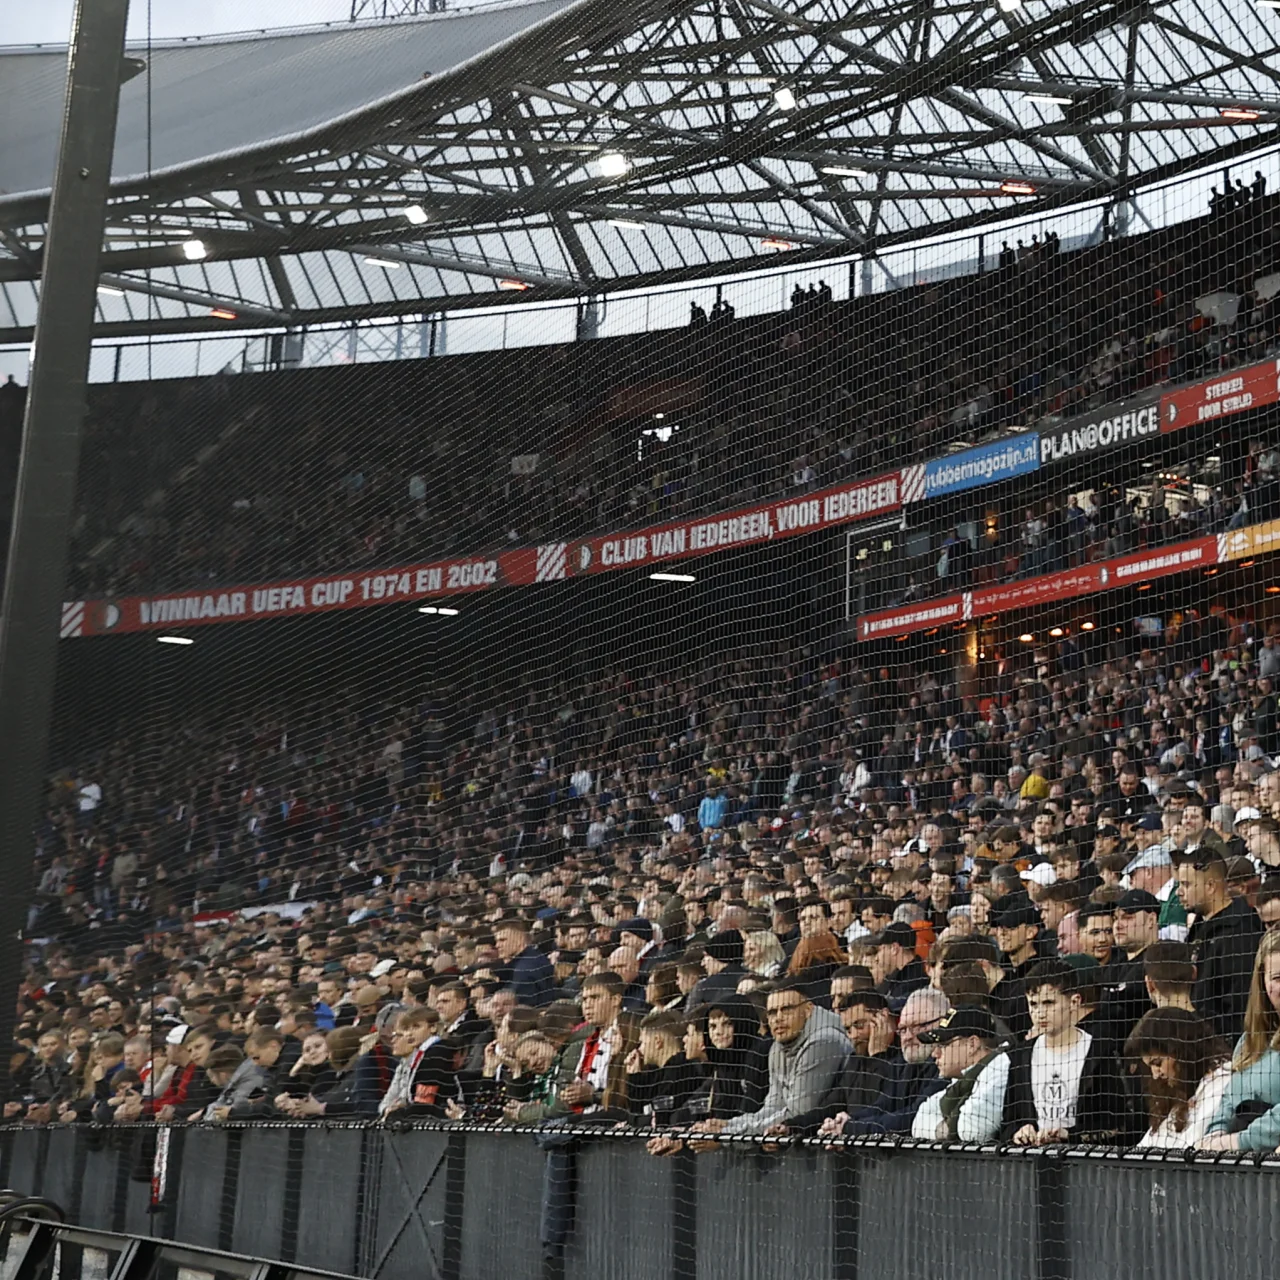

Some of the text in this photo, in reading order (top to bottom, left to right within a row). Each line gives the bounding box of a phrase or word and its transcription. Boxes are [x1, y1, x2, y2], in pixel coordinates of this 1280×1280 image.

[1041, 405, 1158, 463] PLAN@OFFICE
[602, 538, 647, 566] CLUB
[651, 530, 685, 557] VAN
[776, 500, 820, 530] VOOR
[824, 478, 900, 521] IEDEREEN
[140, 561, 497, 624] WINNAAR UEFA CUP 1974 EN 2002
